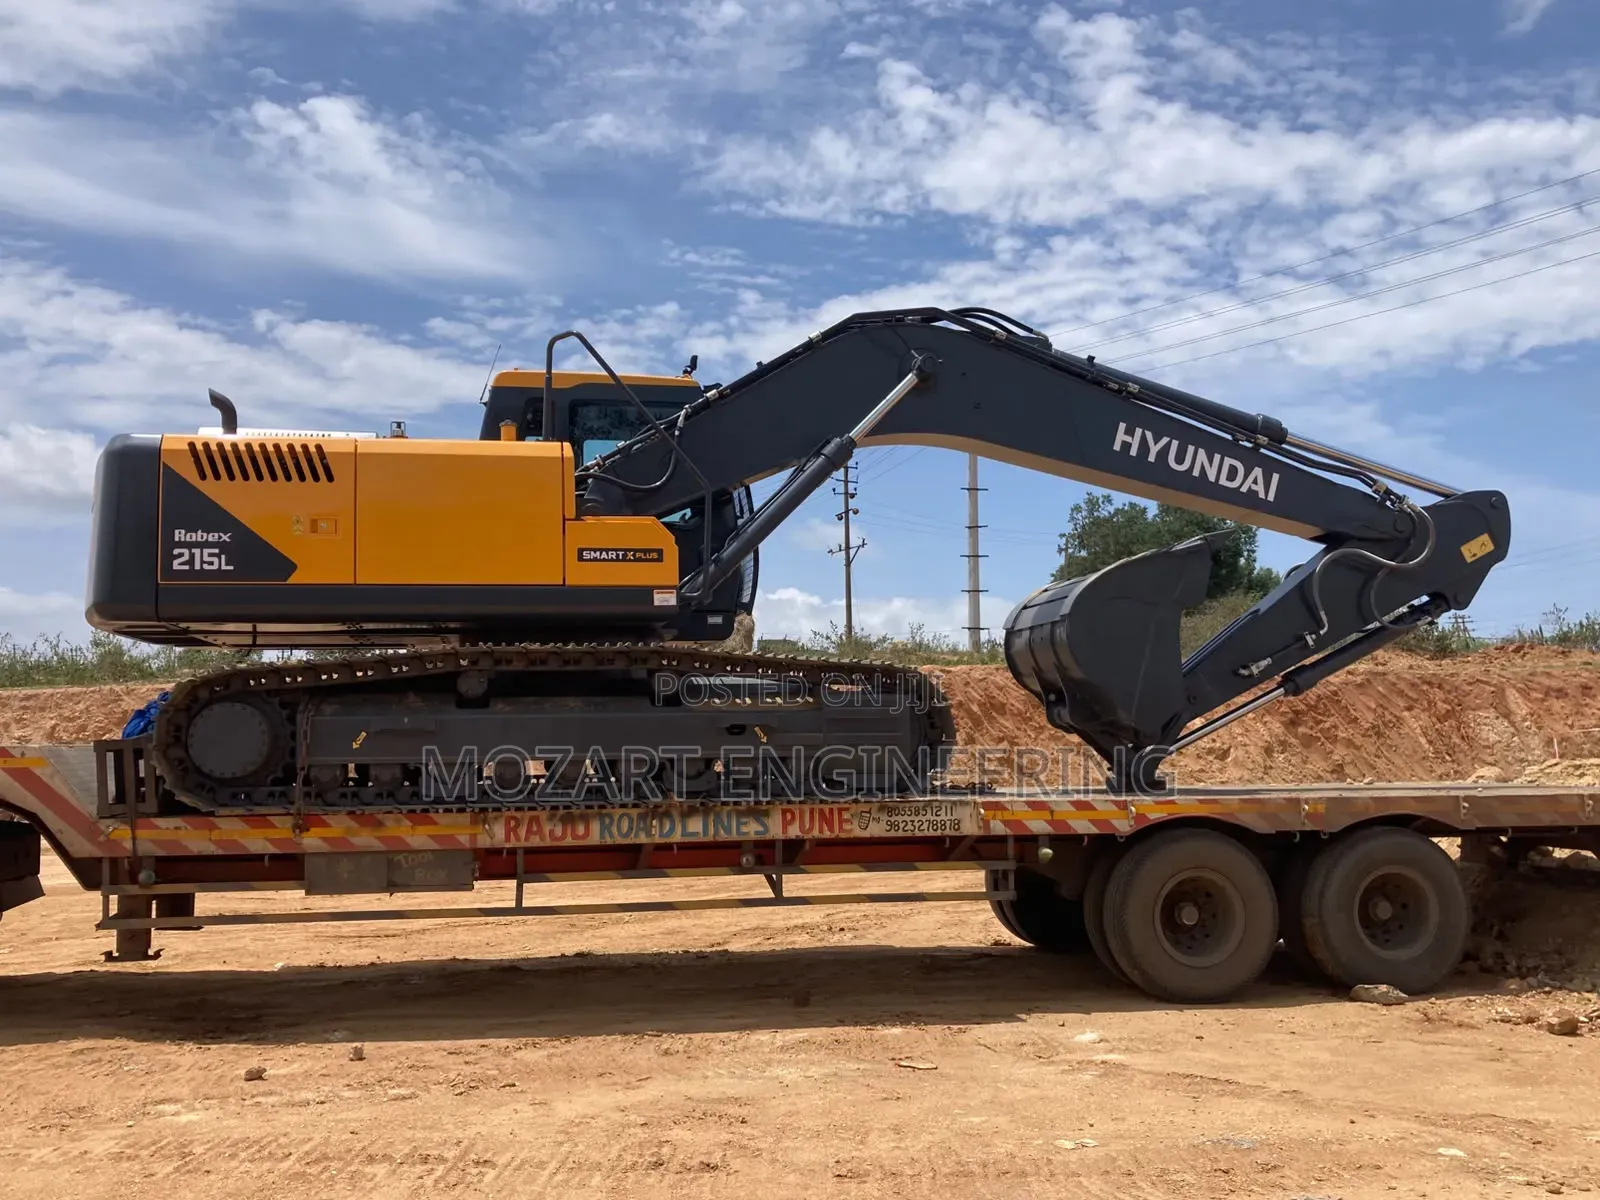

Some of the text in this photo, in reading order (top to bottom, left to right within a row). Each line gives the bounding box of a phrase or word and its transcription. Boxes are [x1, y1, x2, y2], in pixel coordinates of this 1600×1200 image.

[1113, 422, 1280, 502] HYUNDAI
[173, 548, 234, 570] 215L
[582, 550, 625, 560] SMART
[504, 810, 591, 843] RAJU
[780, 806, 852, 835] PUNE
[885, 818, 961, 833] 9823278878
